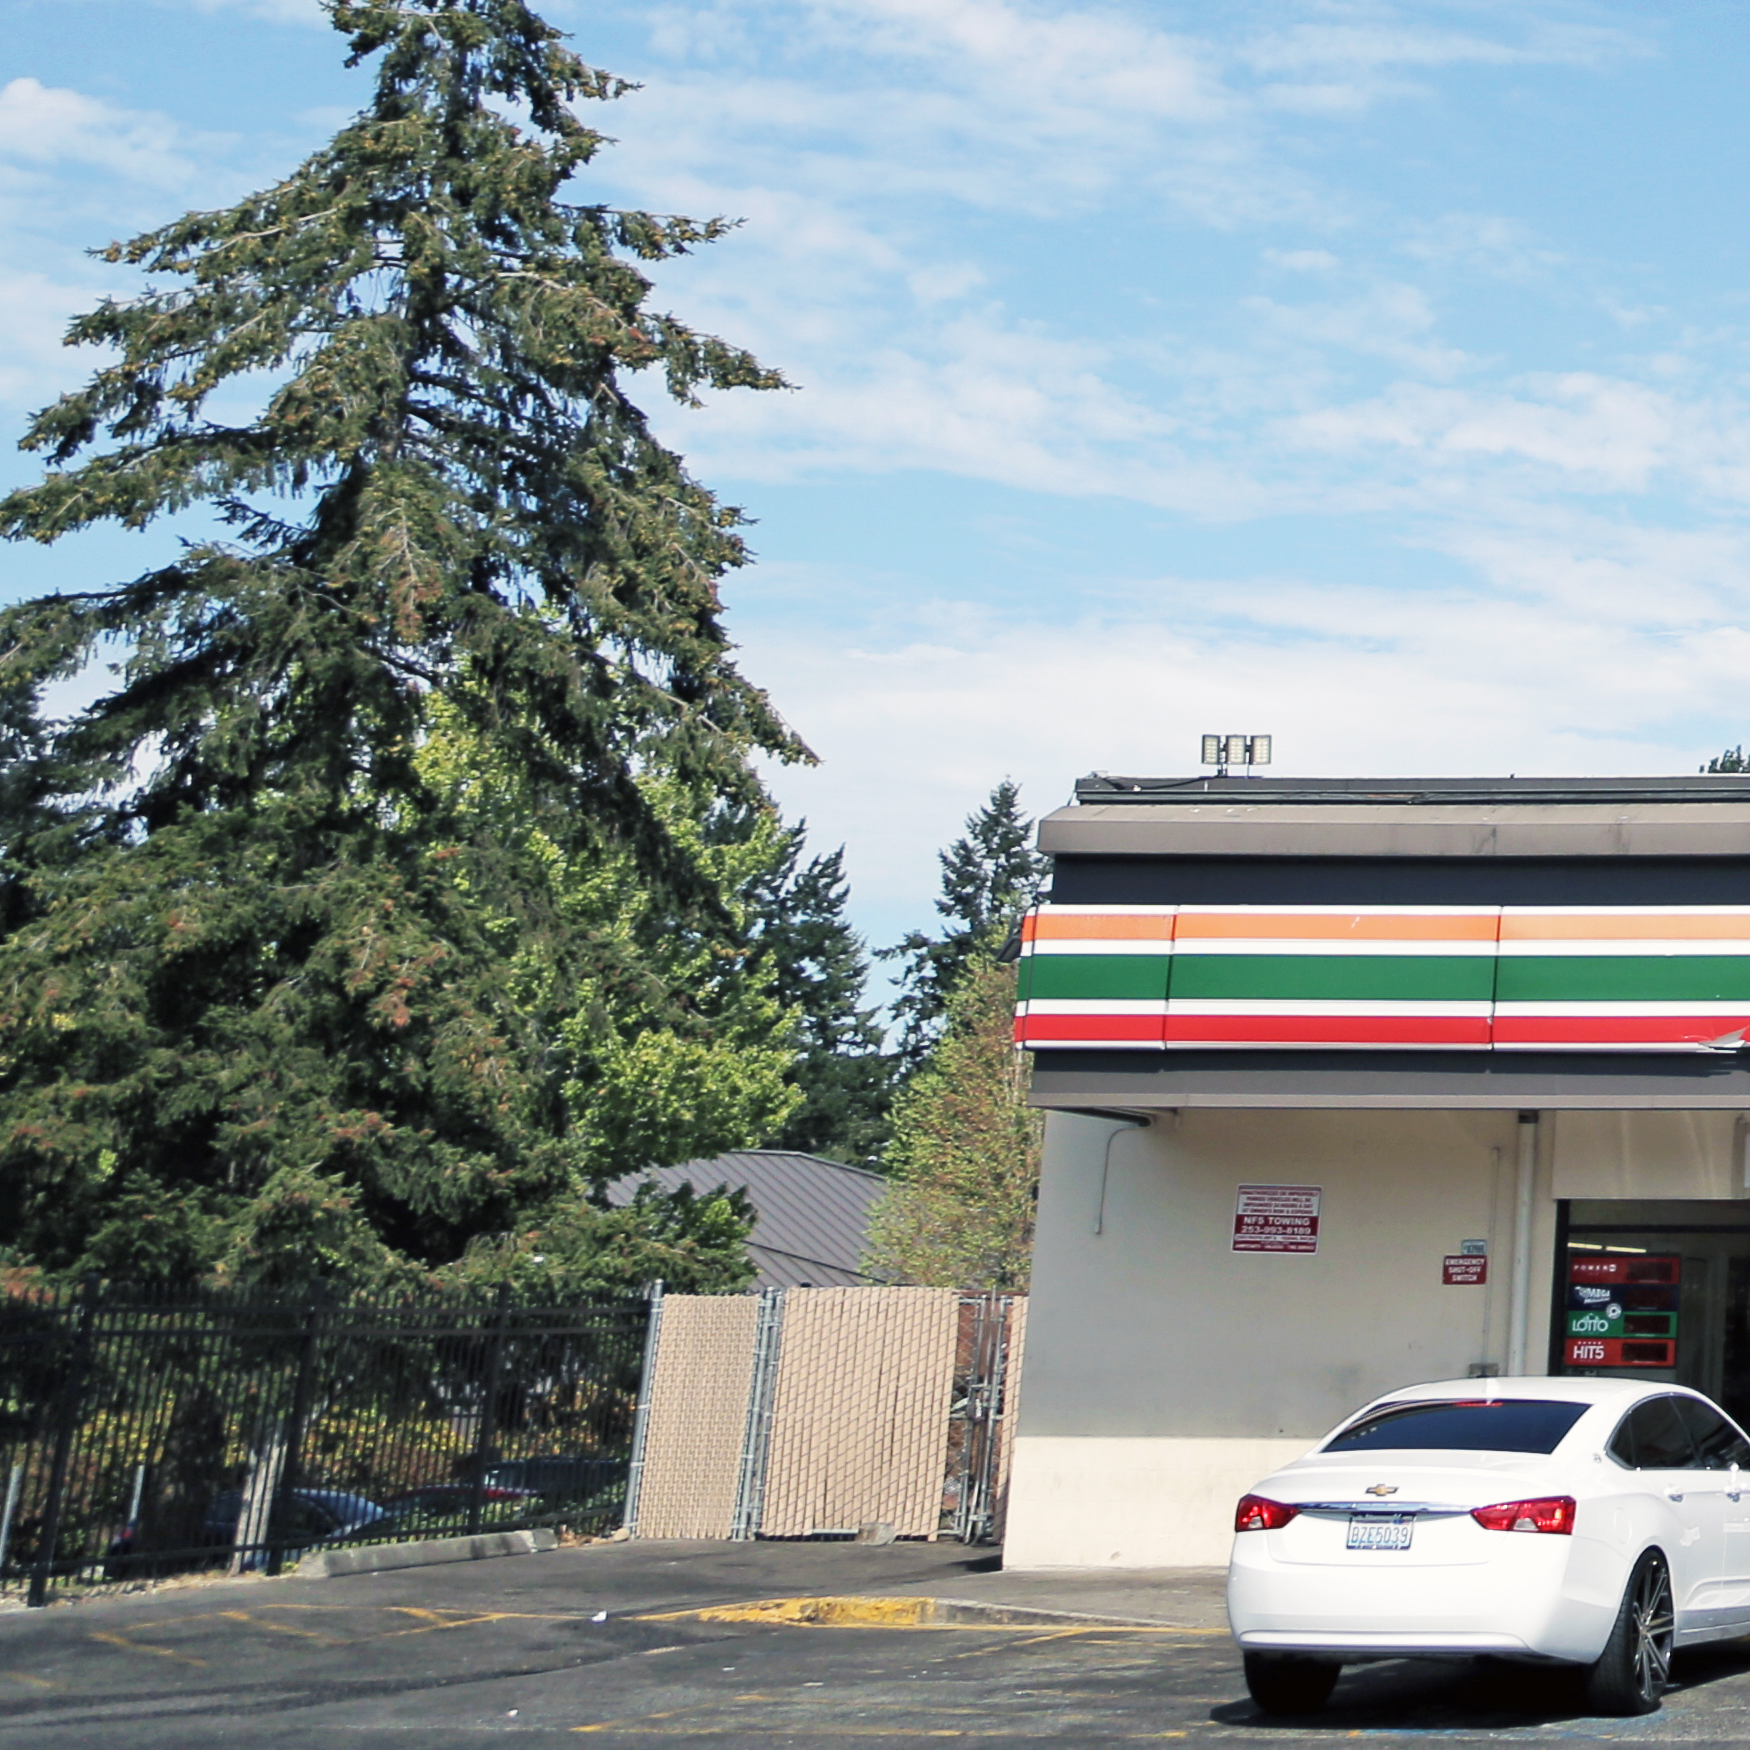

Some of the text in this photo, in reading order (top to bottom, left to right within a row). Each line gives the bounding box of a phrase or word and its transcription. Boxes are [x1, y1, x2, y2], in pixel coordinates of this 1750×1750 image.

[1243, 1216, 1310, 1226] NFS TOWING
[1572, 1319, 1609, 1332] LOTTO
[1573, 1345, 1605, 1359] HIT5
